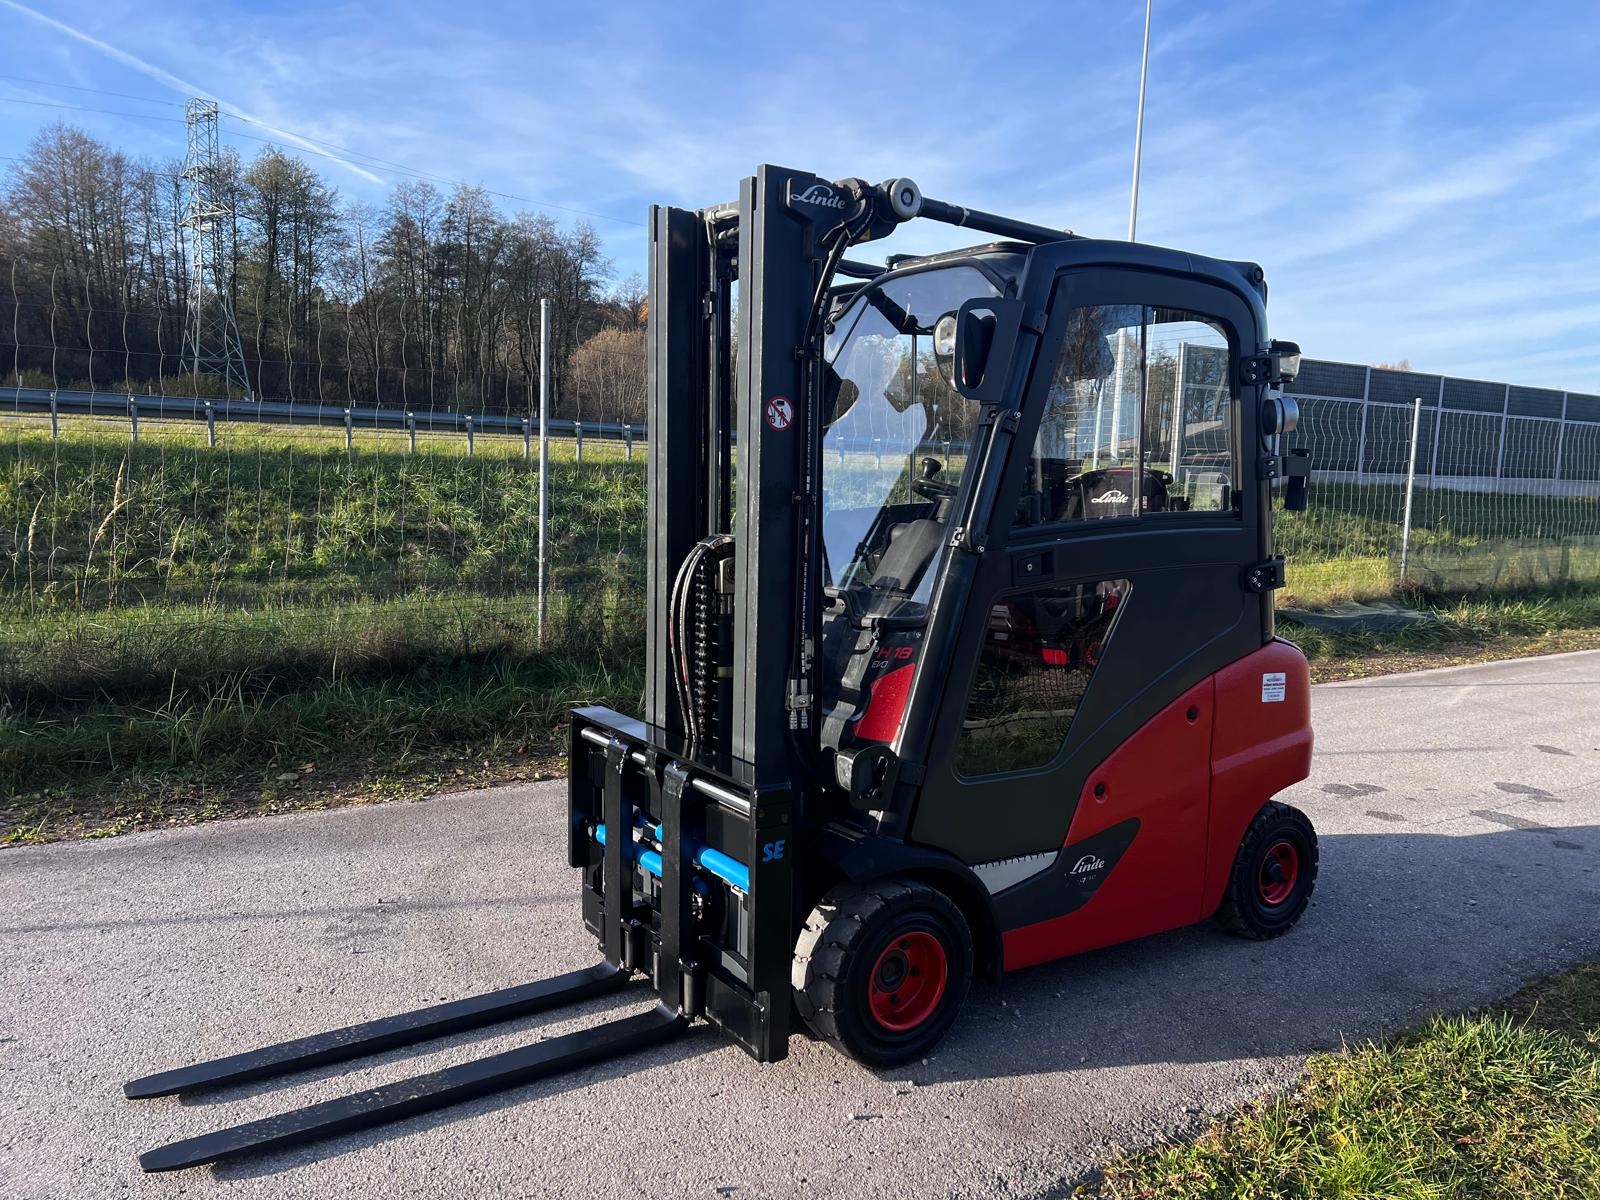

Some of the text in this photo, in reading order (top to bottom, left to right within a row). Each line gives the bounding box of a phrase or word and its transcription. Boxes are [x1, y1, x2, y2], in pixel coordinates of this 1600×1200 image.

[791, 184, 846, 209] Linde
[1091, 489, 1129, 504] Linde
[762, 840, 785, 862] SE
[1069, 854, 1105, 874] Linde
